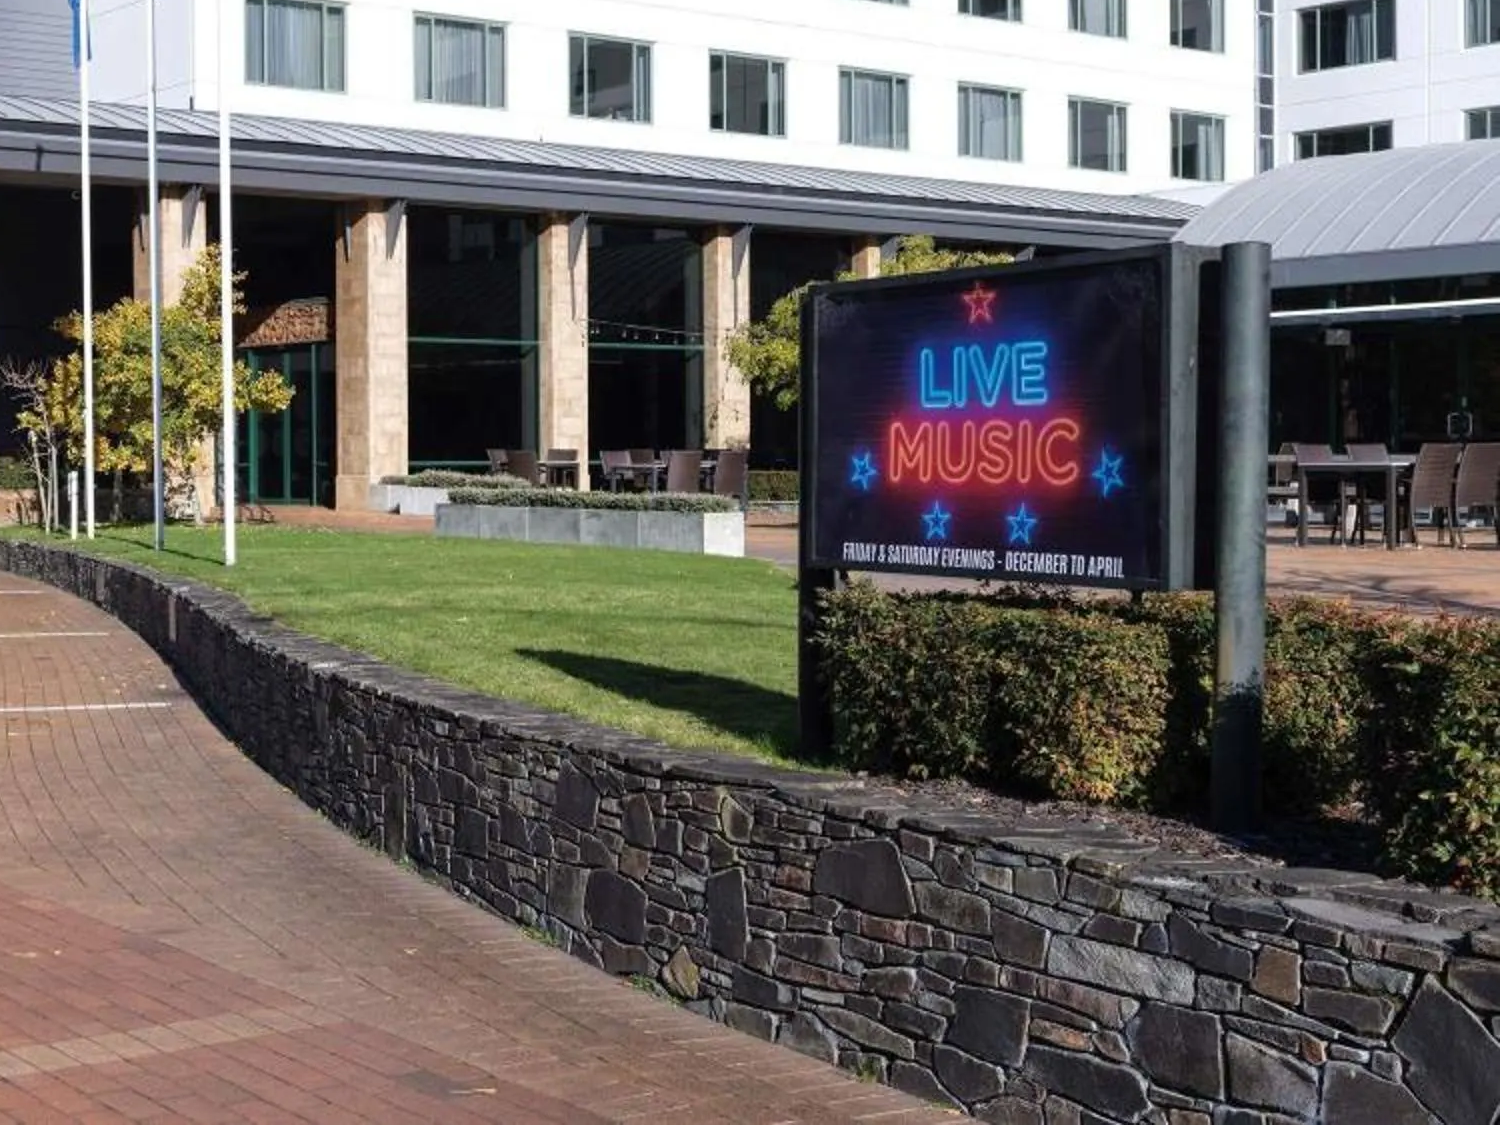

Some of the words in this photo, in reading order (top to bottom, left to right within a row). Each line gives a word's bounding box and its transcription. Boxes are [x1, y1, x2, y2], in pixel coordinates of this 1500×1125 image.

[920, 340, 1049, 409] LIVE
[889, 417, 1081, 485] MUSIC
[843, 542, 877, 562] FRIDAY
[878, 544, 886, 563] &
[887, 544, 940, 566] SATURDAY
[941, 548, 995, 570] EVENINGS
[1005, 551, 1068, 574] DECEMBER
[1070, 554, 1085, 576] TO
[1087, 556, 1125, 578] APRIL
